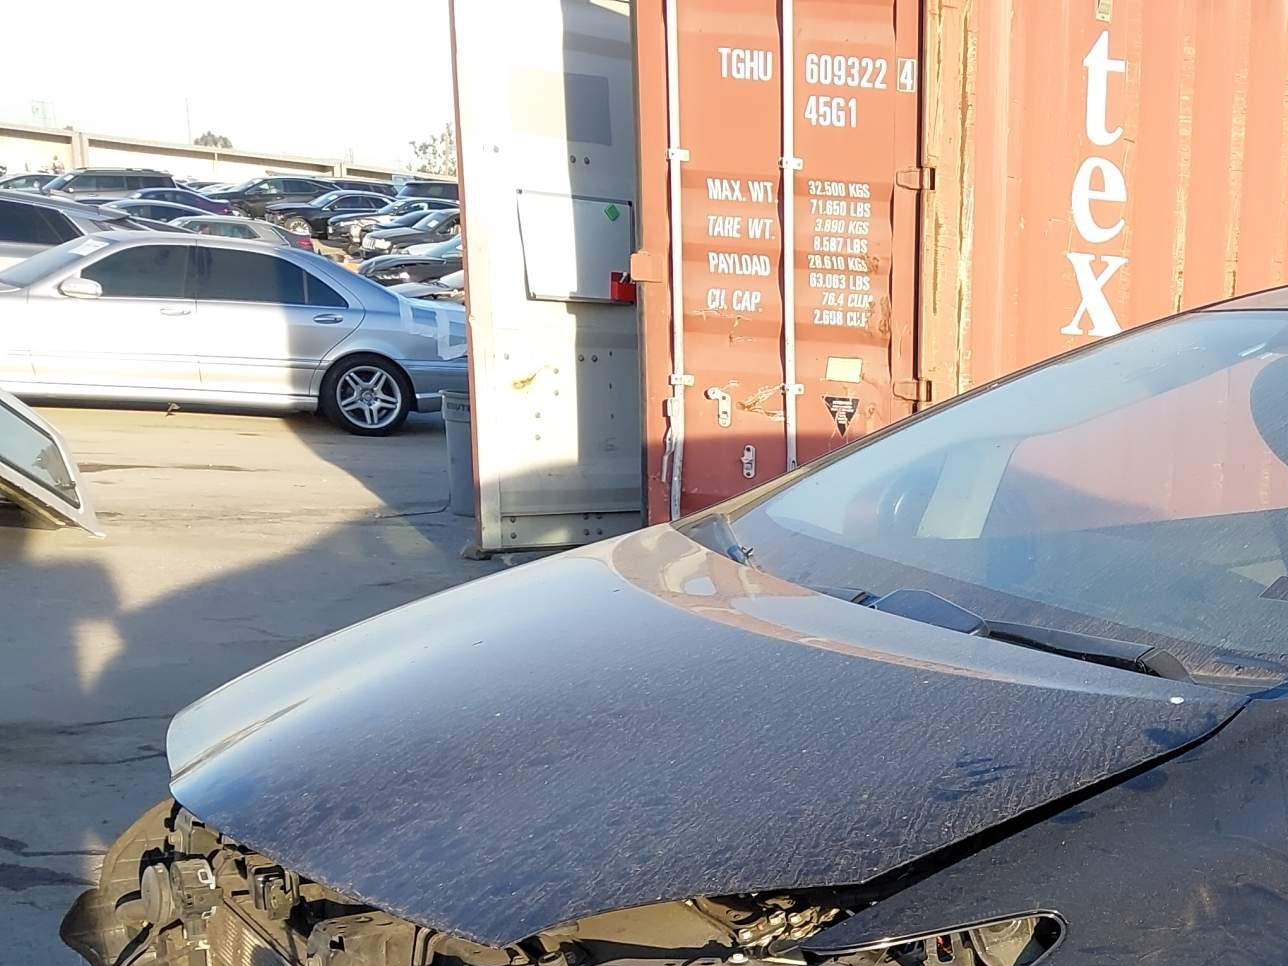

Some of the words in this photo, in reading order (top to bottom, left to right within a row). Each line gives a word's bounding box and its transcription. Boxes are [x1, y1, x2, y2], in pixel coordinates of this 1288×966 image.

[717, 47, 774, 81] TGHU
[805, 53, 888, 89] 609322
[899, 59, 914, 92] 4
[804, 95, 857, 128] 45G1
[706, 178, 747, 201] MAX.
[808, 181, 845, 197] 32.500
[848, 183, 871, 199] KGS
[849, 202, 872, 218] LBS
[707, 215, 742, 238] TARE
[748, 218, 777, 241] WT.
[847, 221, 870, 236] KGS
[847, 238, 868, 254] LBS
[708, 252, 771, 276] PAYLOAD
[847, 256, 868, 272] KGS
[849, 275, 871, 291] LBS
